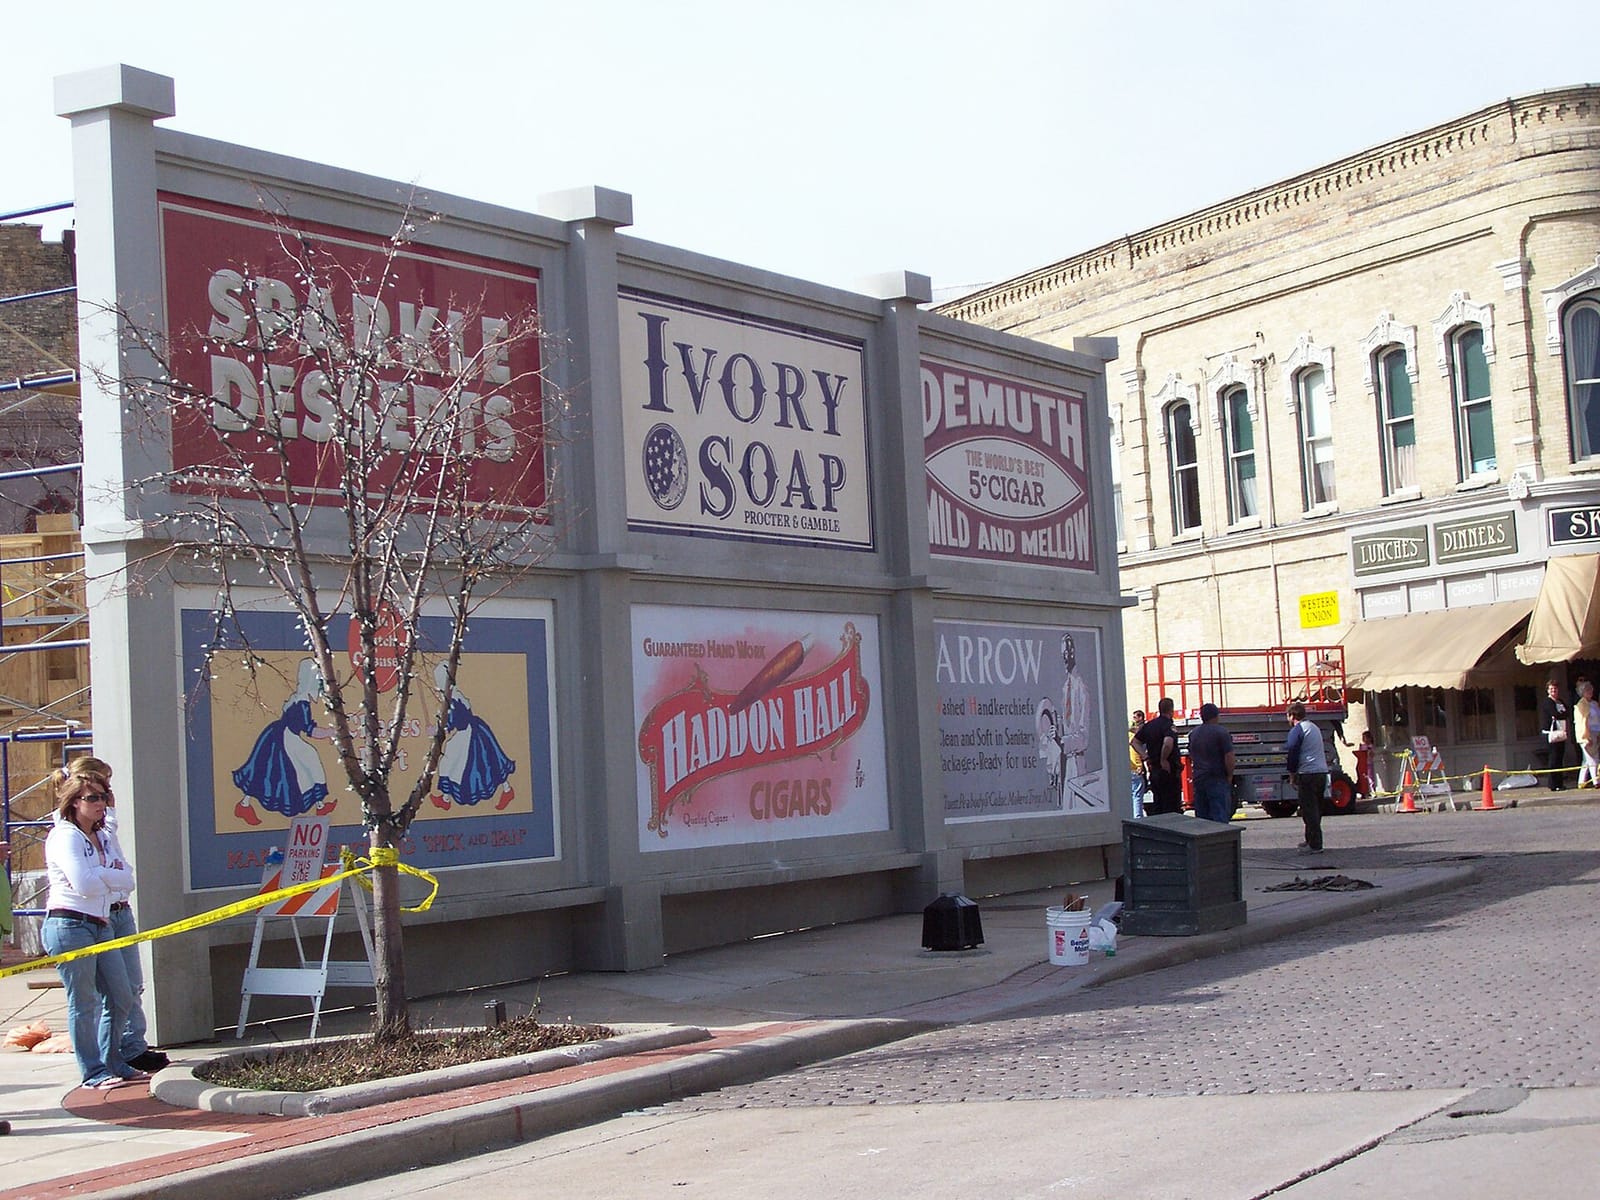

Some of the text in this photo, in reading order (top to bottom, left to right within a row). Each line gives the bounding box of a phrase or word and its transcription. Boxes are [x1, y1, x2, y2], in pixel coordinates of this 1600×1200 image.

[638, 312, 848, 436] IVORY
[920, 367, 1085, 472] DEMUTH
[965, 450, 1046, 477] THE WORLD'S BEST
[699, 435, 847, 520] SOAP
[988, 475, 1046, 507] CIGAR
[744, 511, 840, 532] PROCTER & GAMBLE
[978, 522, 1015, 553] AND
[1021, 502, 1089, 562] MELLOW
[1443, 524, 1505, 552] DINNERS
[1360, 539, 1418, 565] LUNCHES
[1452, 583, 1485, 597] CHOPS
[1500, 575, 1540, 591] STEAKS
[1301, 595, 1336, 610] WESTERN
[1414, 590, 1435, 601] FISH
[1306, 610, 1333, 623] UNION
[643, 638, 767, 659] GUARANTEED HAND WORK
[936, 634, 1043, 685] ARROW
[969, 697, 1034, 716] Handkerchiefs
[662, 667, 857, 793] HADDON HALL
[961, 729, 975, 746] and
[976, 728, 993, 746] Soft
[995, 730, 1003, 745] in
[1005, 727, 1035, 748] Sanitary
[1006, 752, 1019, 769] for
[1022, 756, 1037, 769] use
[750, 778, 833, 820] CIGARS
[294, 824, 322, 846] NO
[289, 849, 320, 858] PARKING
[295, 860, 311, 870] THIS
[291, 871, 309, 881] SIDE
